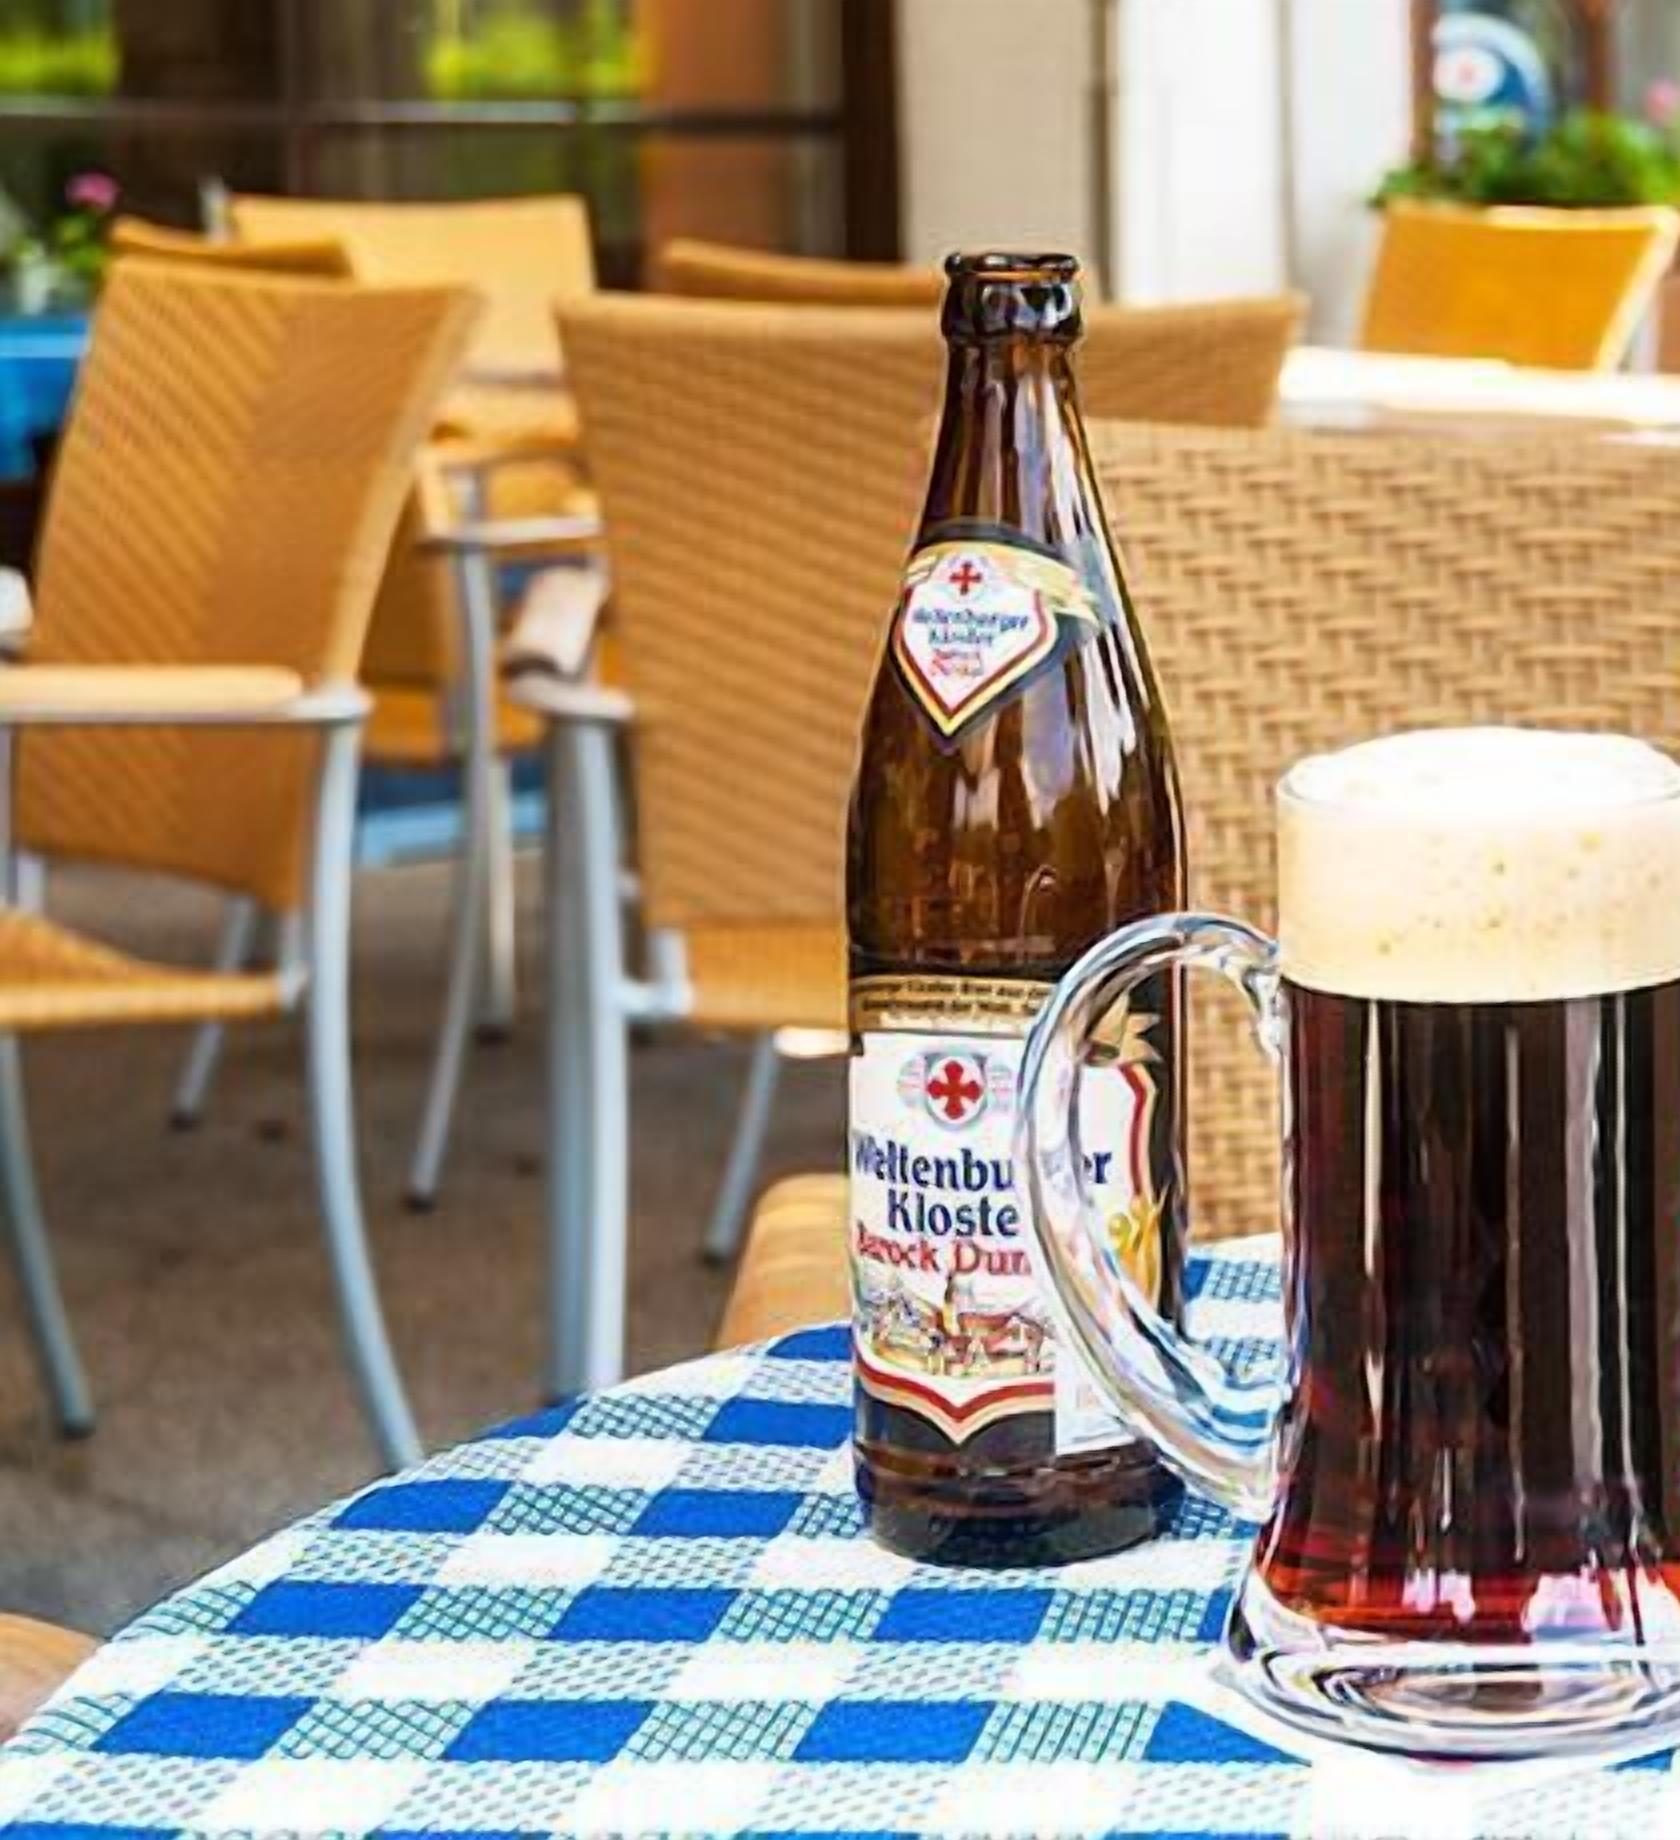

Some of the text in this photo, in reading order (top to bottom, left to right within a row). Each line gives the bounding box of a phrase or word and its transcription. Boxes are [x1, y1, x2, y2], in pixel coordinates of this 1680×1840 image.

[856, 1134, 1113, 1192] Weltenbur
[887, 1188, 1021, 1237] Kloste
[951, 1237, 1033, 1276] Dun
